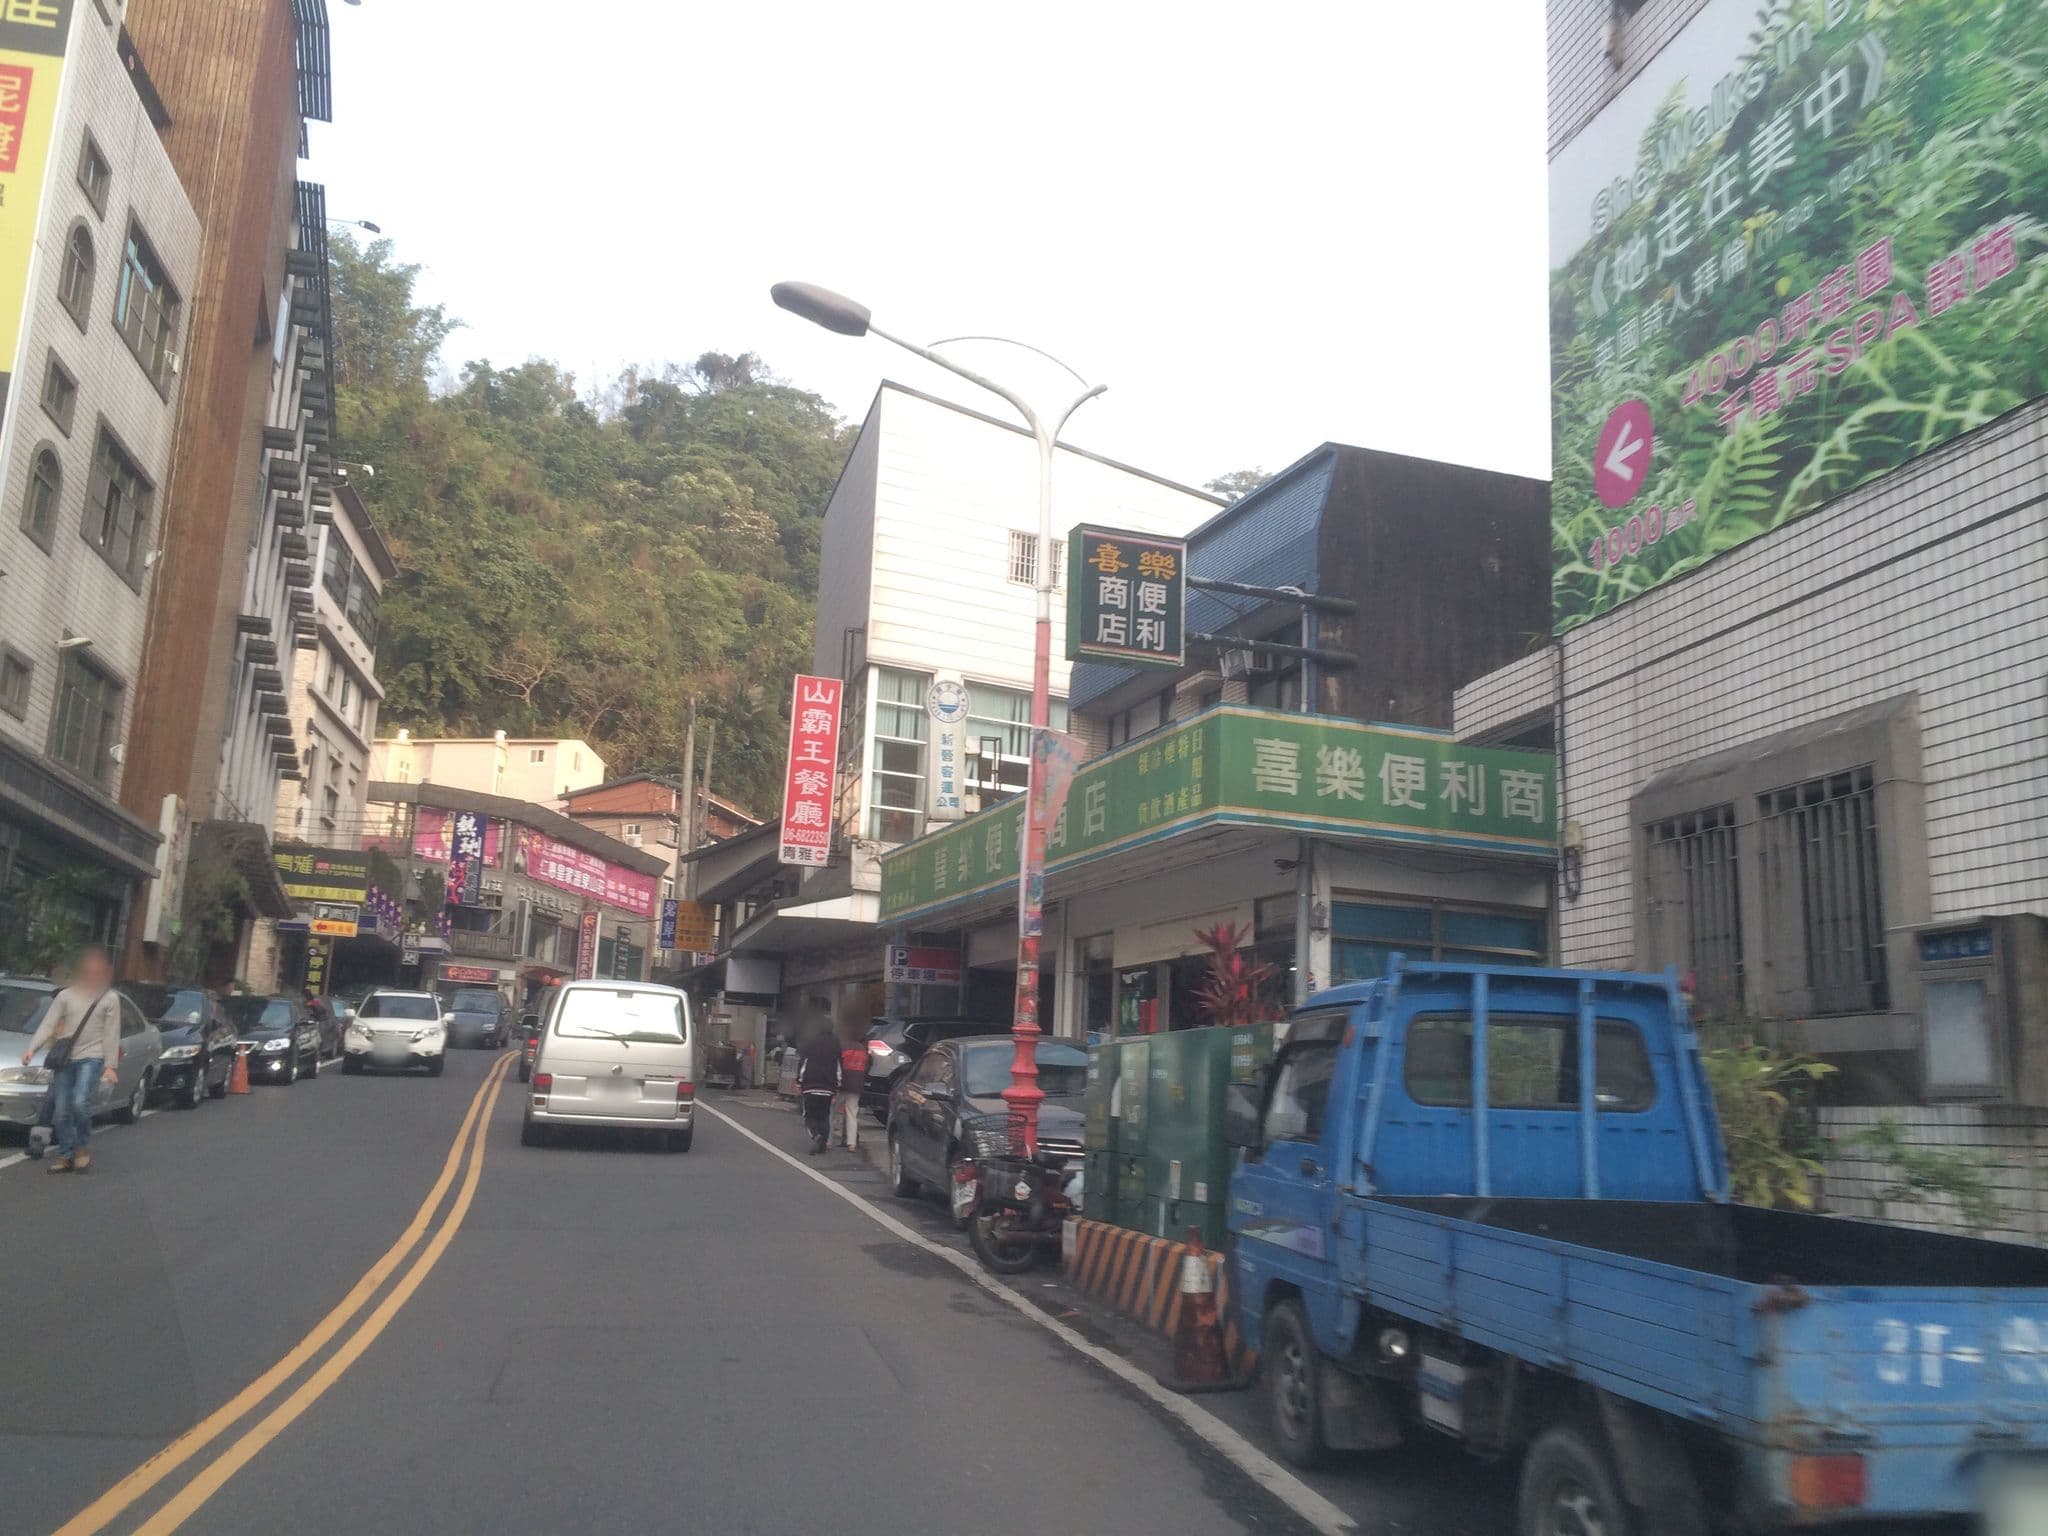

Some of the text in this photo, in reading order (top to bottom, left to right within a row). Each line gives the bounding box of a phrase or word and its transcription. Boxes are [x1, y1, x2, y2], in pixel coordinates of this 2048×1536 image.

[1776, 21, 1813, 74] in
[1088, 542, 1177, 581] 喜樂
[1096, 575, 1129, 646] 商店
[1136, 580, 1168, 651] 便利
[789, 680, 834, 828] 山霸王餐廳
[1251, 738, 1546, 824] 喜樂便利商
[895, 949, 908, 965] P
